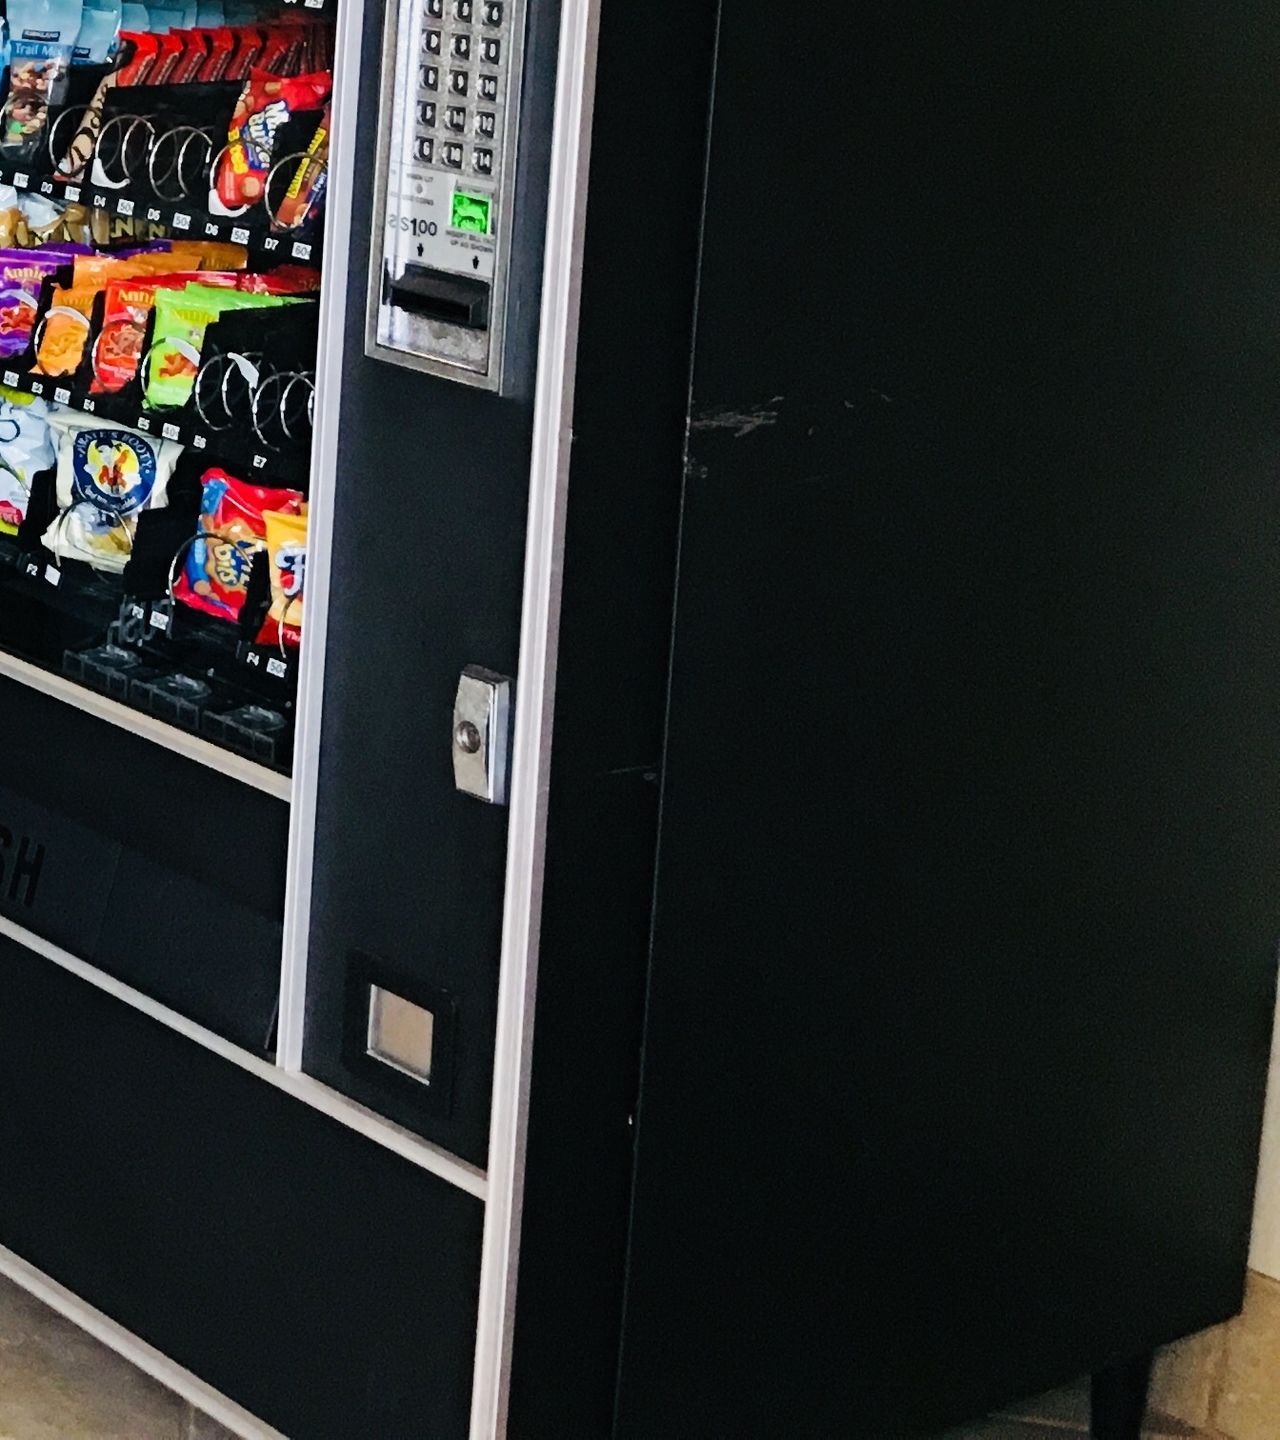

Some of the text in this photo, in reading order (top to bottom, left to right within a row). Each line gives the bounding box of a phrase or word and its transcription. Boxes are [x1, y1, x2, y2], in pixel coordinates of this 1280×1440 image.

[16, 42, 38, 56] Trail
[94, 195, 106, 207] D4
[265, 238, 279, 250] D7
